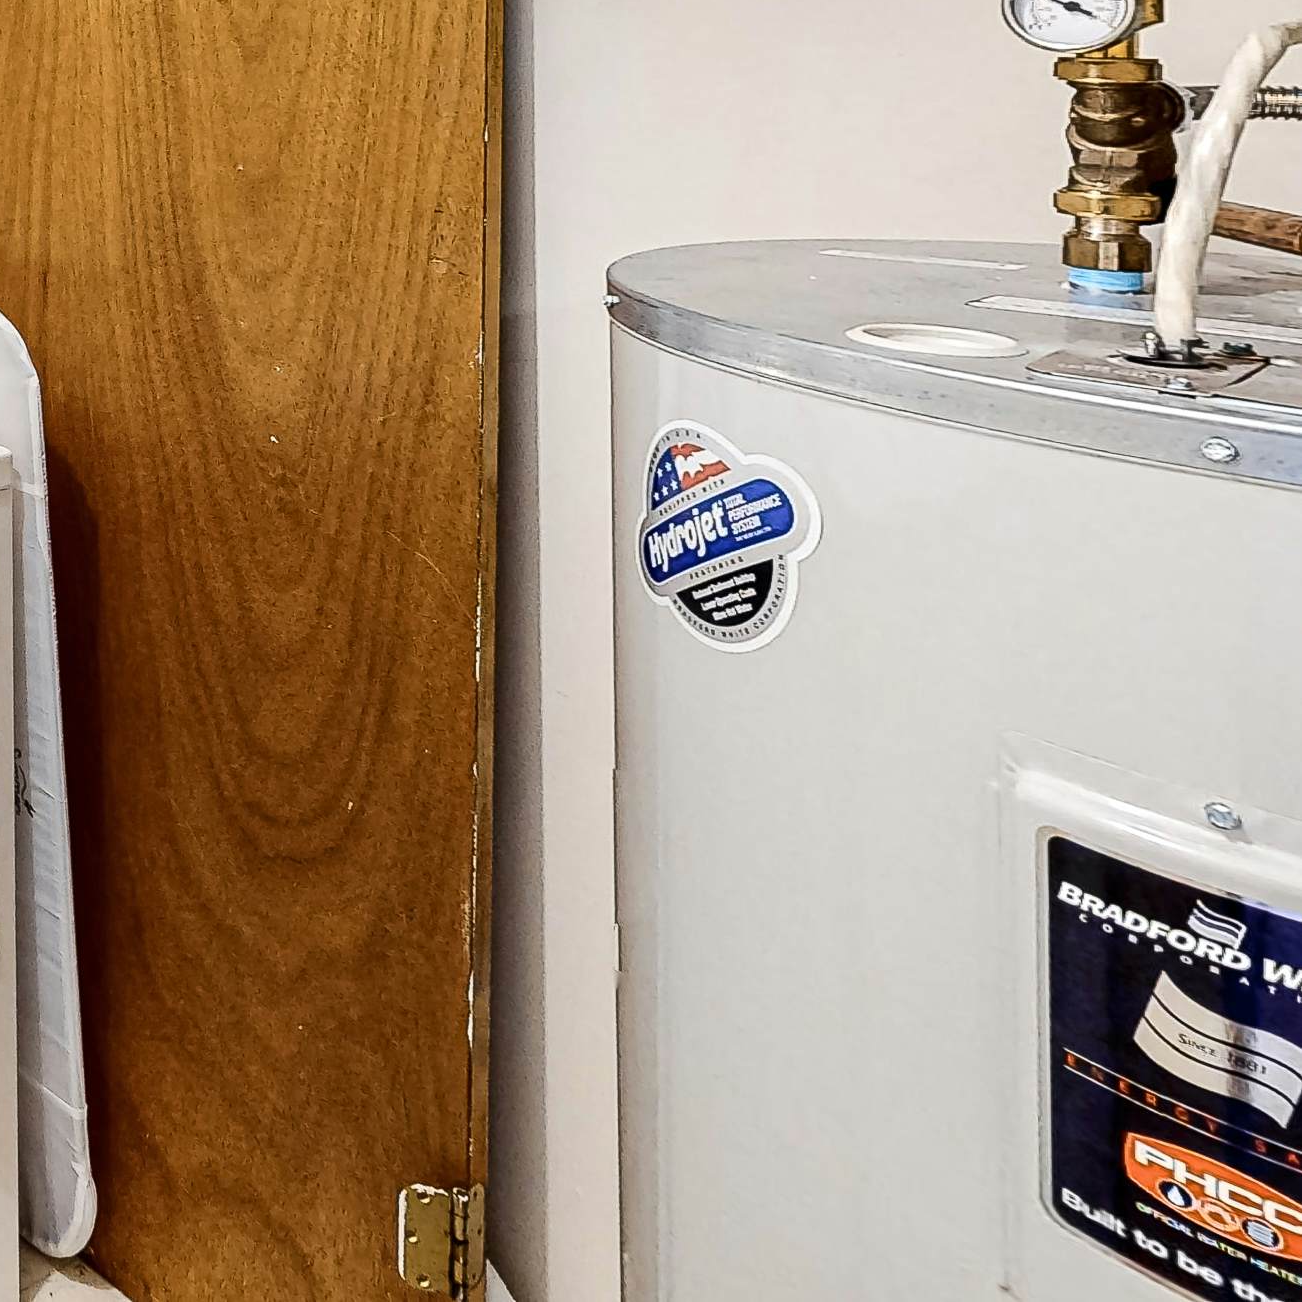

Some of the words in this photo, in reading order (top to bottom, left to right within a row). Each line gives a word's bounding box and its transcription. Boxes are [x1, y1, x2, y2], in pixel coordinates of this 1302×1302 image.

[648, 499, 728, 573] Hydrojet
[728, 494, 782, 522] PERFORMANCE
[689, 556, 745, 580] FEATURING
[1057, 881, 1252, 971] BRADFORD
[1065, 1053, 1218, 1132] ENERGY
[1134, 1140, 1302, 1235] PHCC
[1062, 1187, 1128, 1238] Built
[1132, 1228, 1168, 1259] to
[1177, 1250, 1224, 1287] be
[1230, 1277, 1291, 1302] th
[1135, 1201, 1194, 1238] OFFICIAL
[1197, 1231, 1248, 1262] WATER
